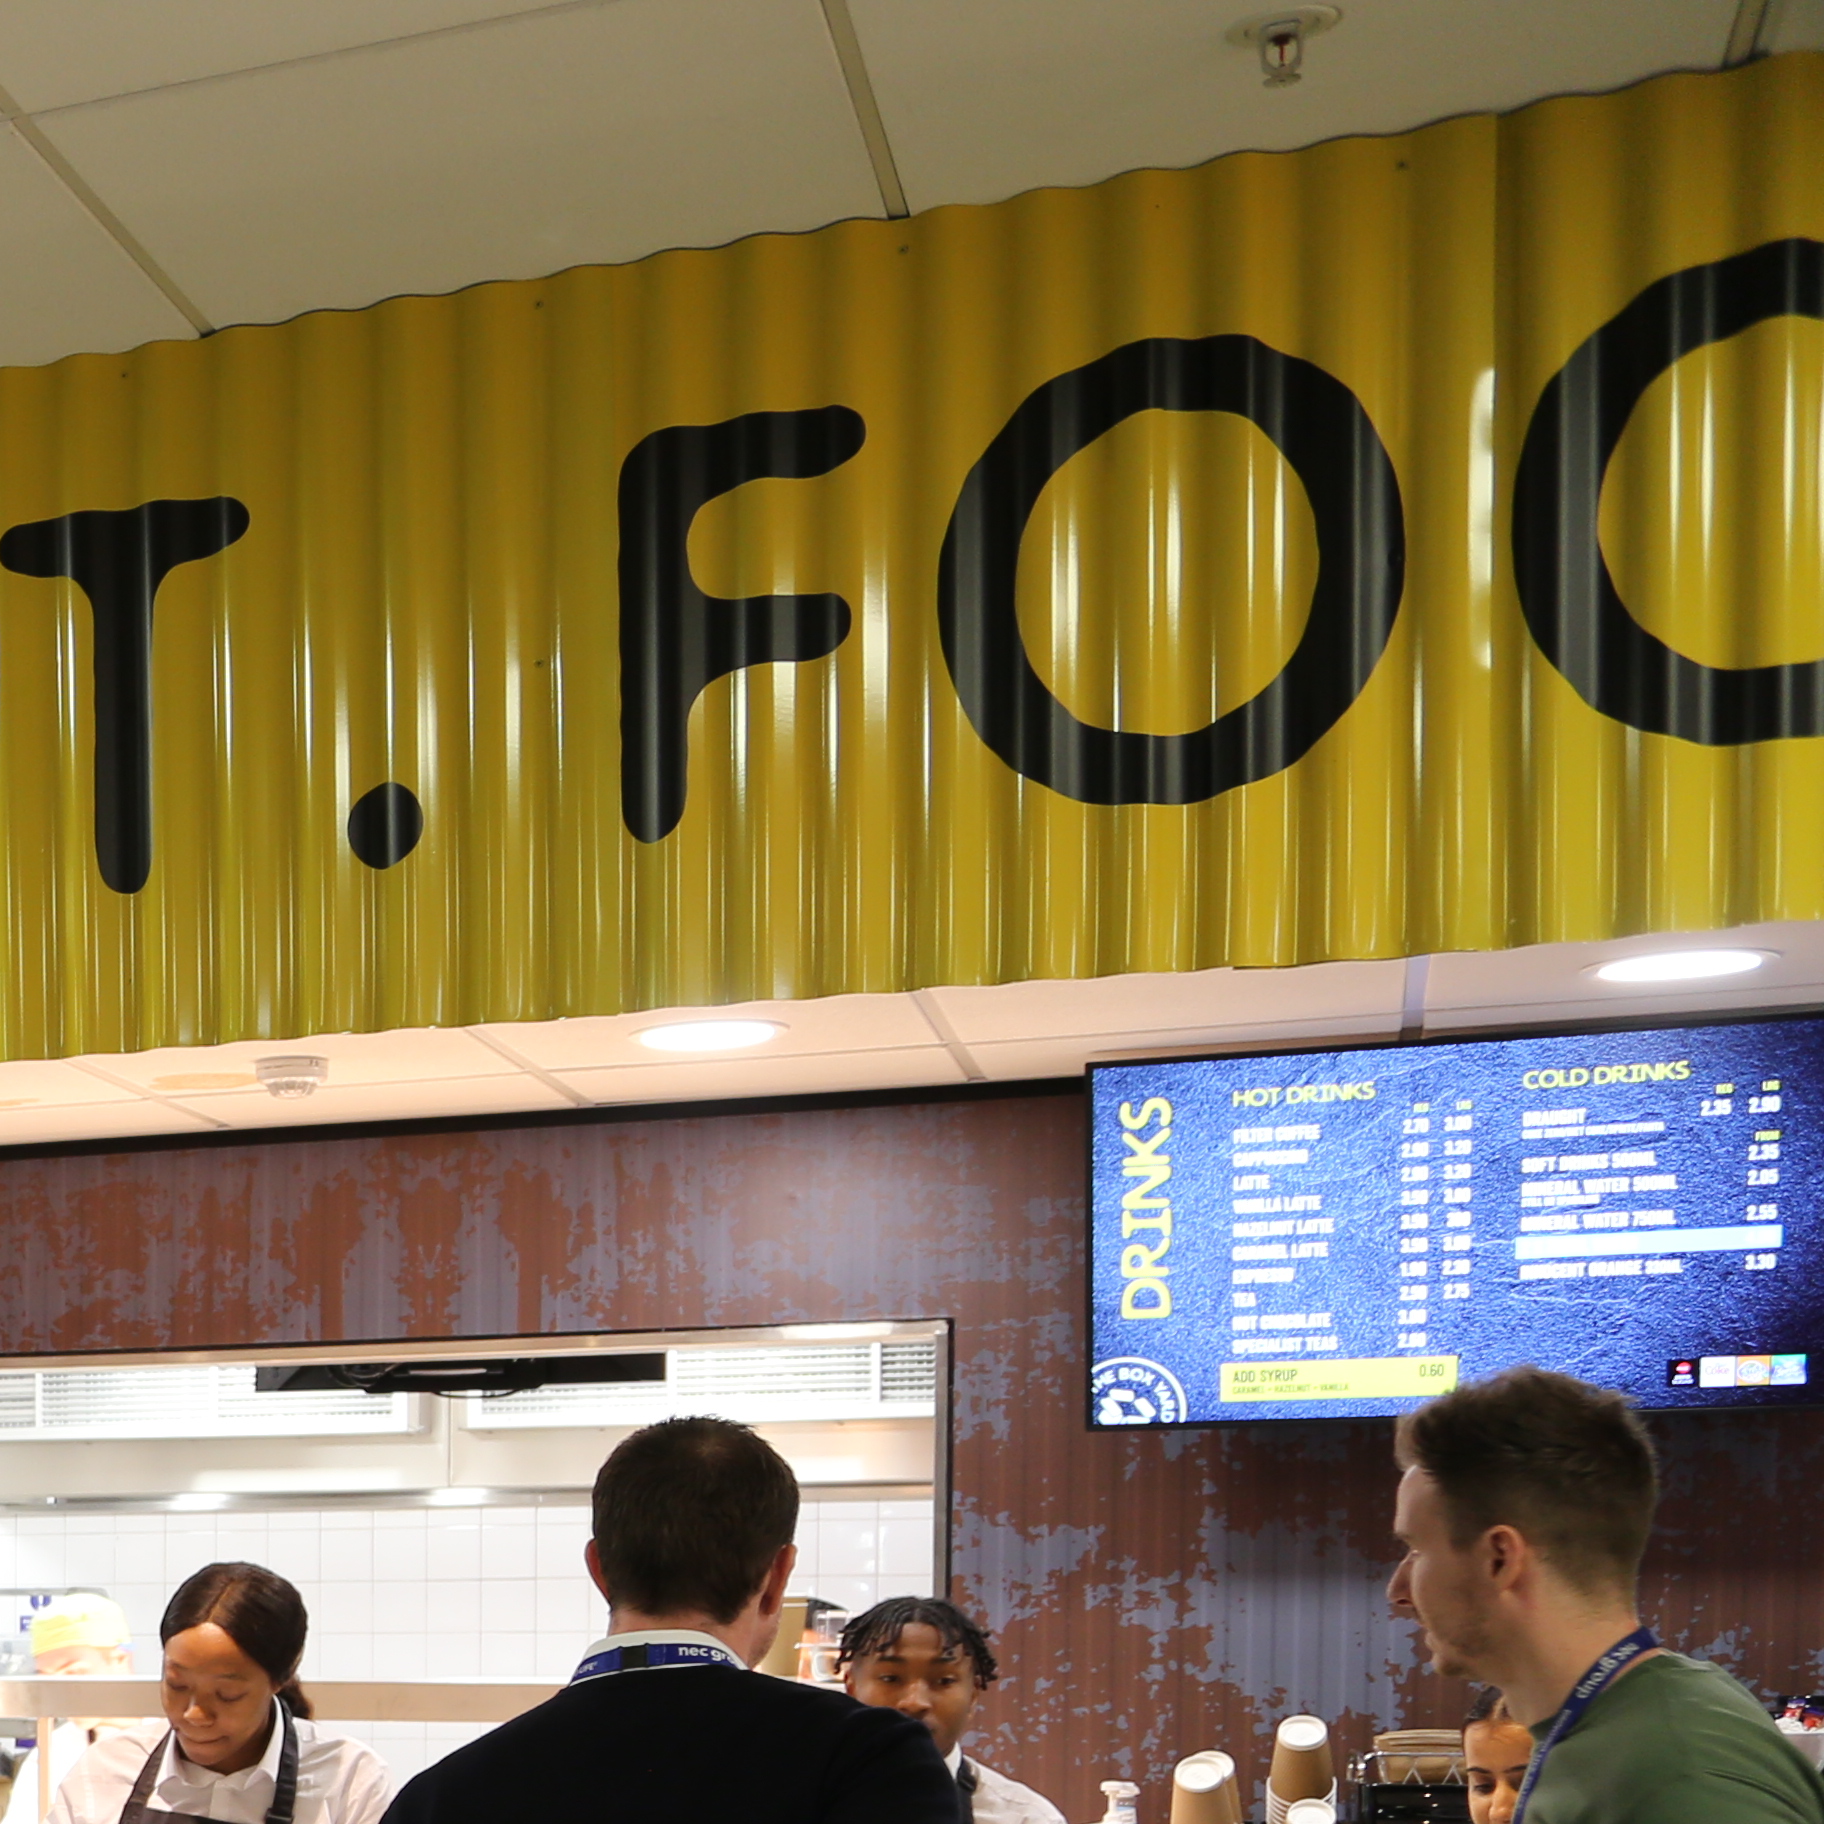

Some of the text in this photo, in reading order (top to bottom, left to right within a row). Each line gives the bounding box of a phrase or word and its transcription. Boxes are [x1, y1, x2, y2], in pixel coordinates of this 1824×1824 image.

[1523, 1061, 1692, 1090] COLD DRINKS
[1232, 1082, 1377, 1108] HOT DRINKS
[1700, 1099, 1732, 1116] 2.35
[1521, 1157, 1557, 1173] SOFT
[1748, 1144, 1780, 1160] 2.35
[1119, 1096, 1173, 1320] DRINKS
[1746, 1204, 1778, 1221] 2.55
[1232, 1364, 1444, 1383] ADD SYRUP 0.60
[1119, 1367, 1156, 1386] BOX
[1154, 1381, 1176, 1423] YARD
[678, 1645, 708, 1657] nec
